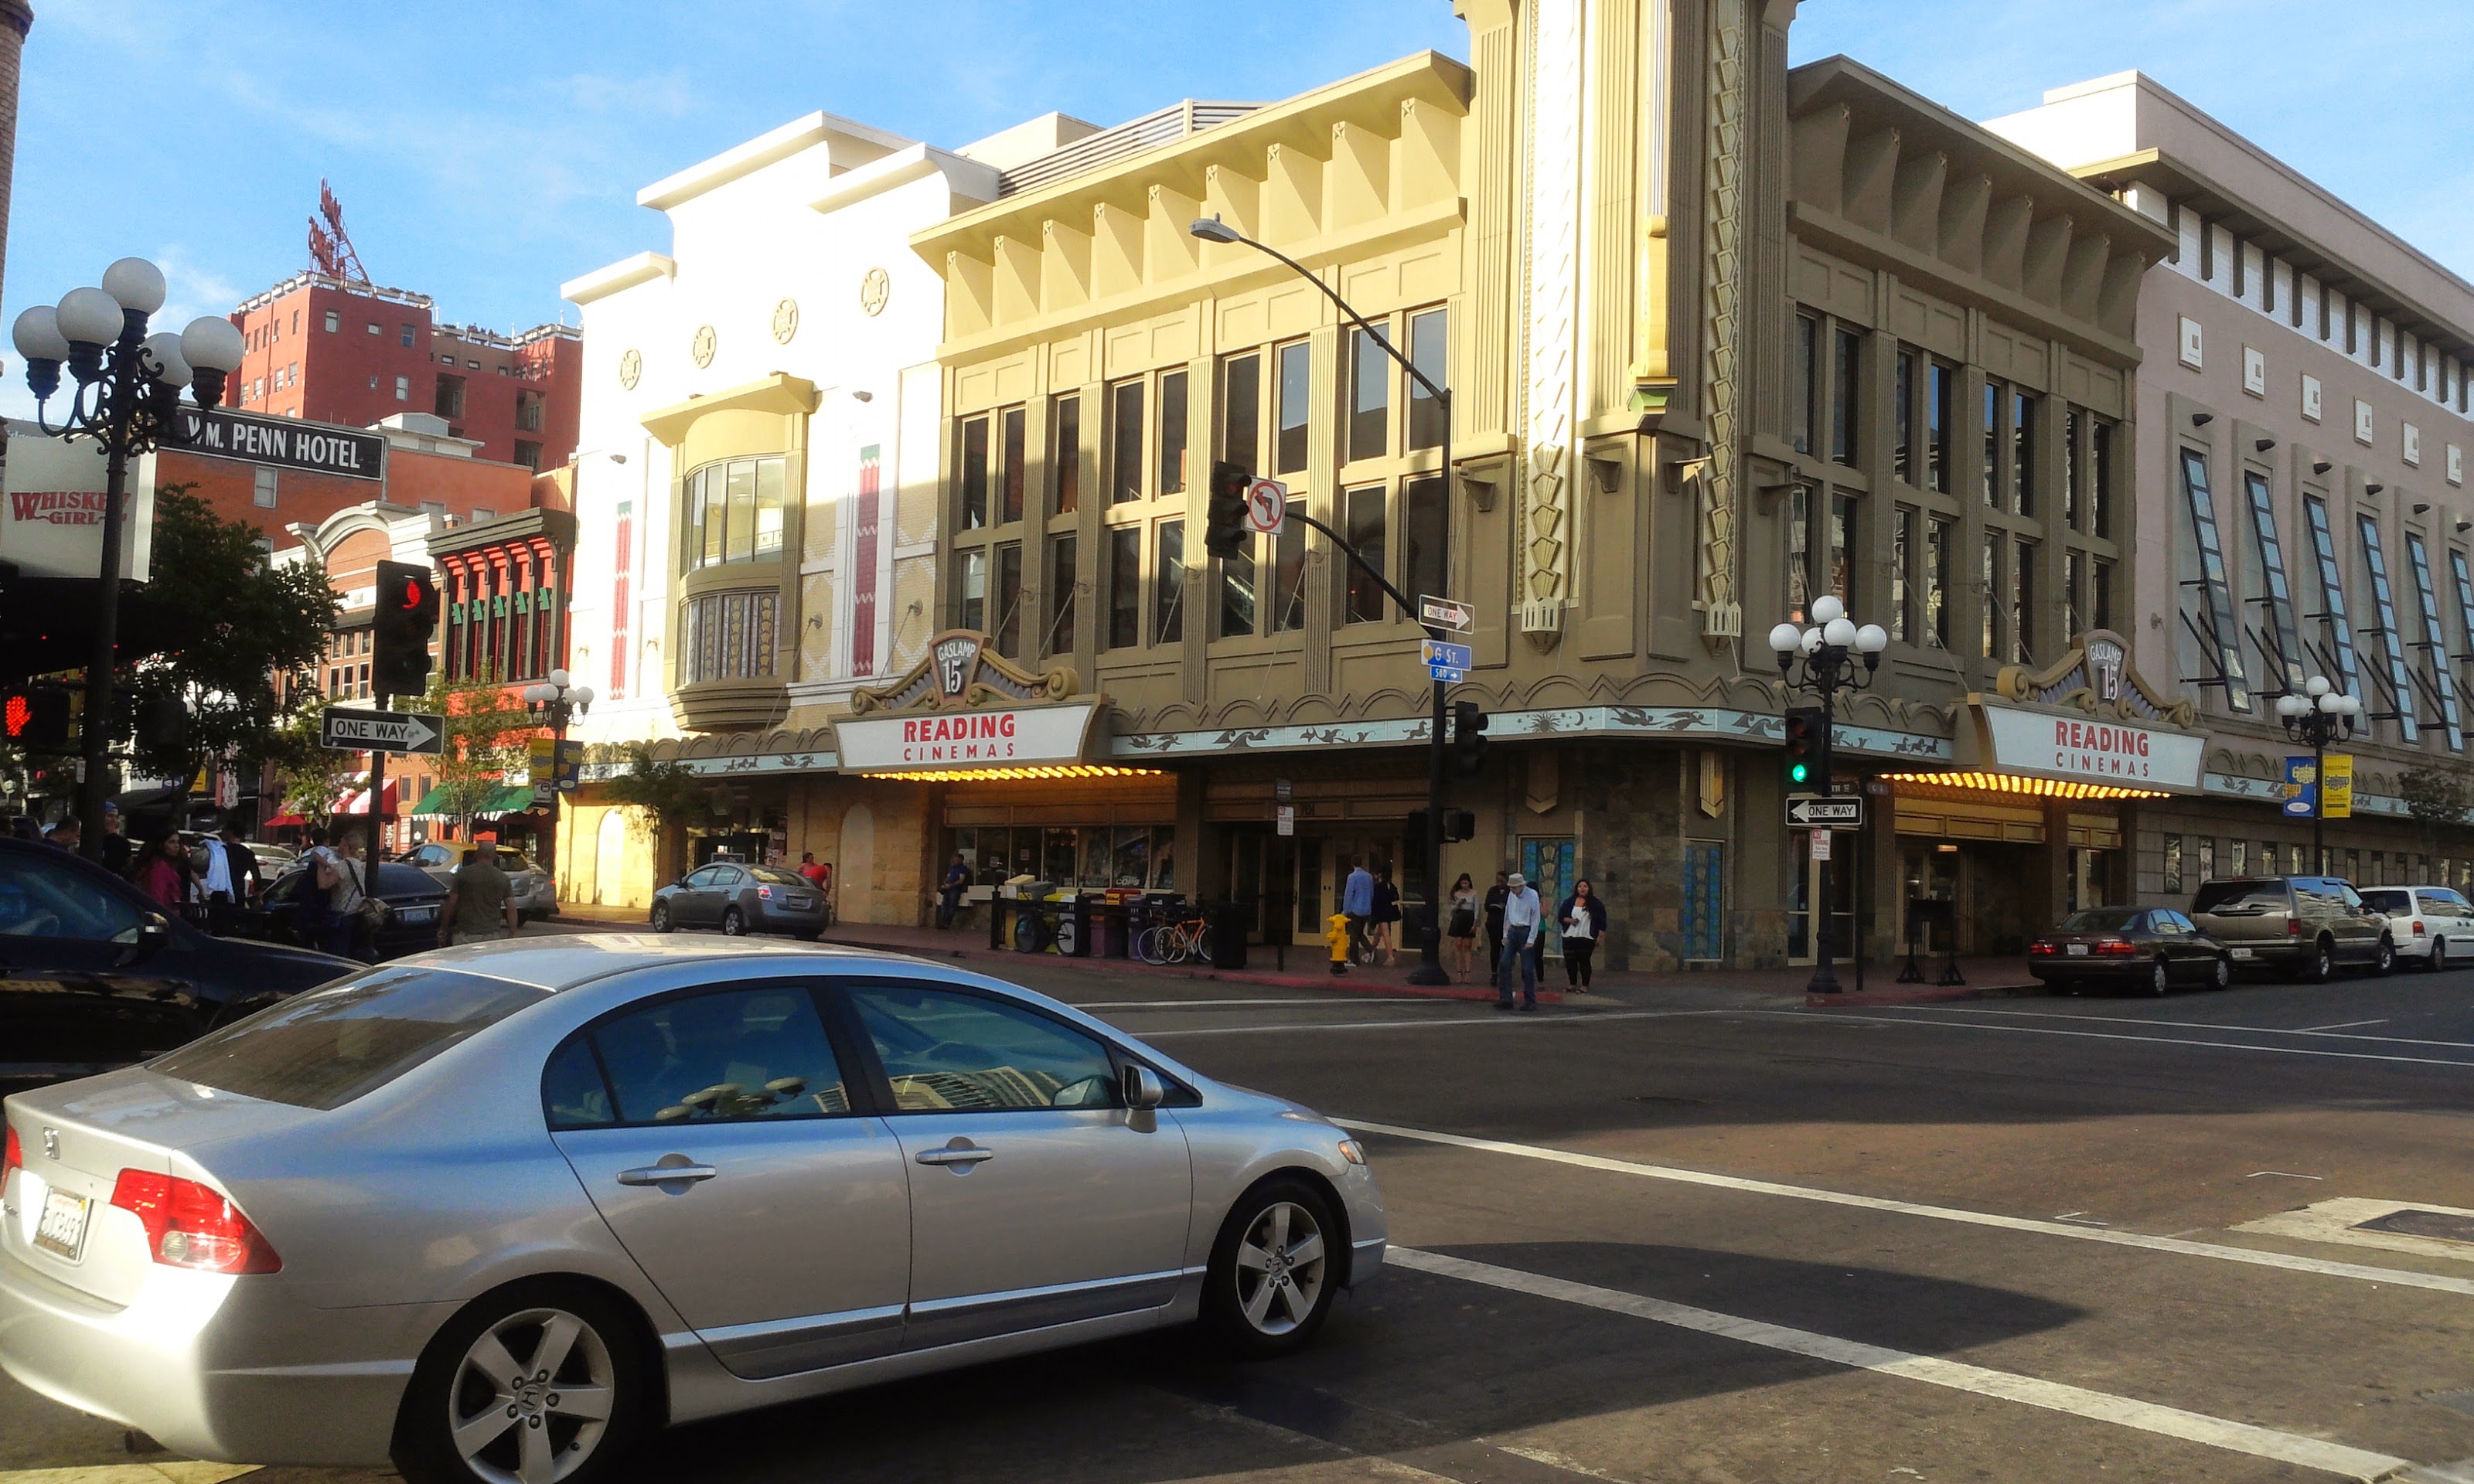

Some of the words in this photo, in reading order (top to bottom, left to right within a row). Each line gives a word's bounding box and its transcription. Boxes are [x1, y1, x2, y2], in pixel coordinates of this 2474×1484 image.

[232, 423, 287, 458] PENN
[295, 433, 361, 469] HOTEL
[10, 491, 131, 522] WHISKE
[48, 511, 99, 525] GIRL
[1427, 606, 1442, 618] ONE
[1443, 610, 1457, 621] WAY
[937, 642, 976, 662] GASLAMP
[1434, 647, 1442, 662] G
[2090, 643, 2121, 665] GASLAMP
[942, 659, 962, 693] 15
[1435, 668, 1447, 679] 500
[2100, 663, 2118, 700] 15
[336, 720, 369, 737] ONE
[376, 723, 408, 740] WAY
[904, 713, 1015, 743] READING
[2056, 720, 2149, 757] READING
[904, 742, 1014, 761] CINEMAS
[2056, 751, 2149, 778] CINEMAS
[1809, 806, 1828, 816] ONE
[1832, 806, 1853, 816] WAY
